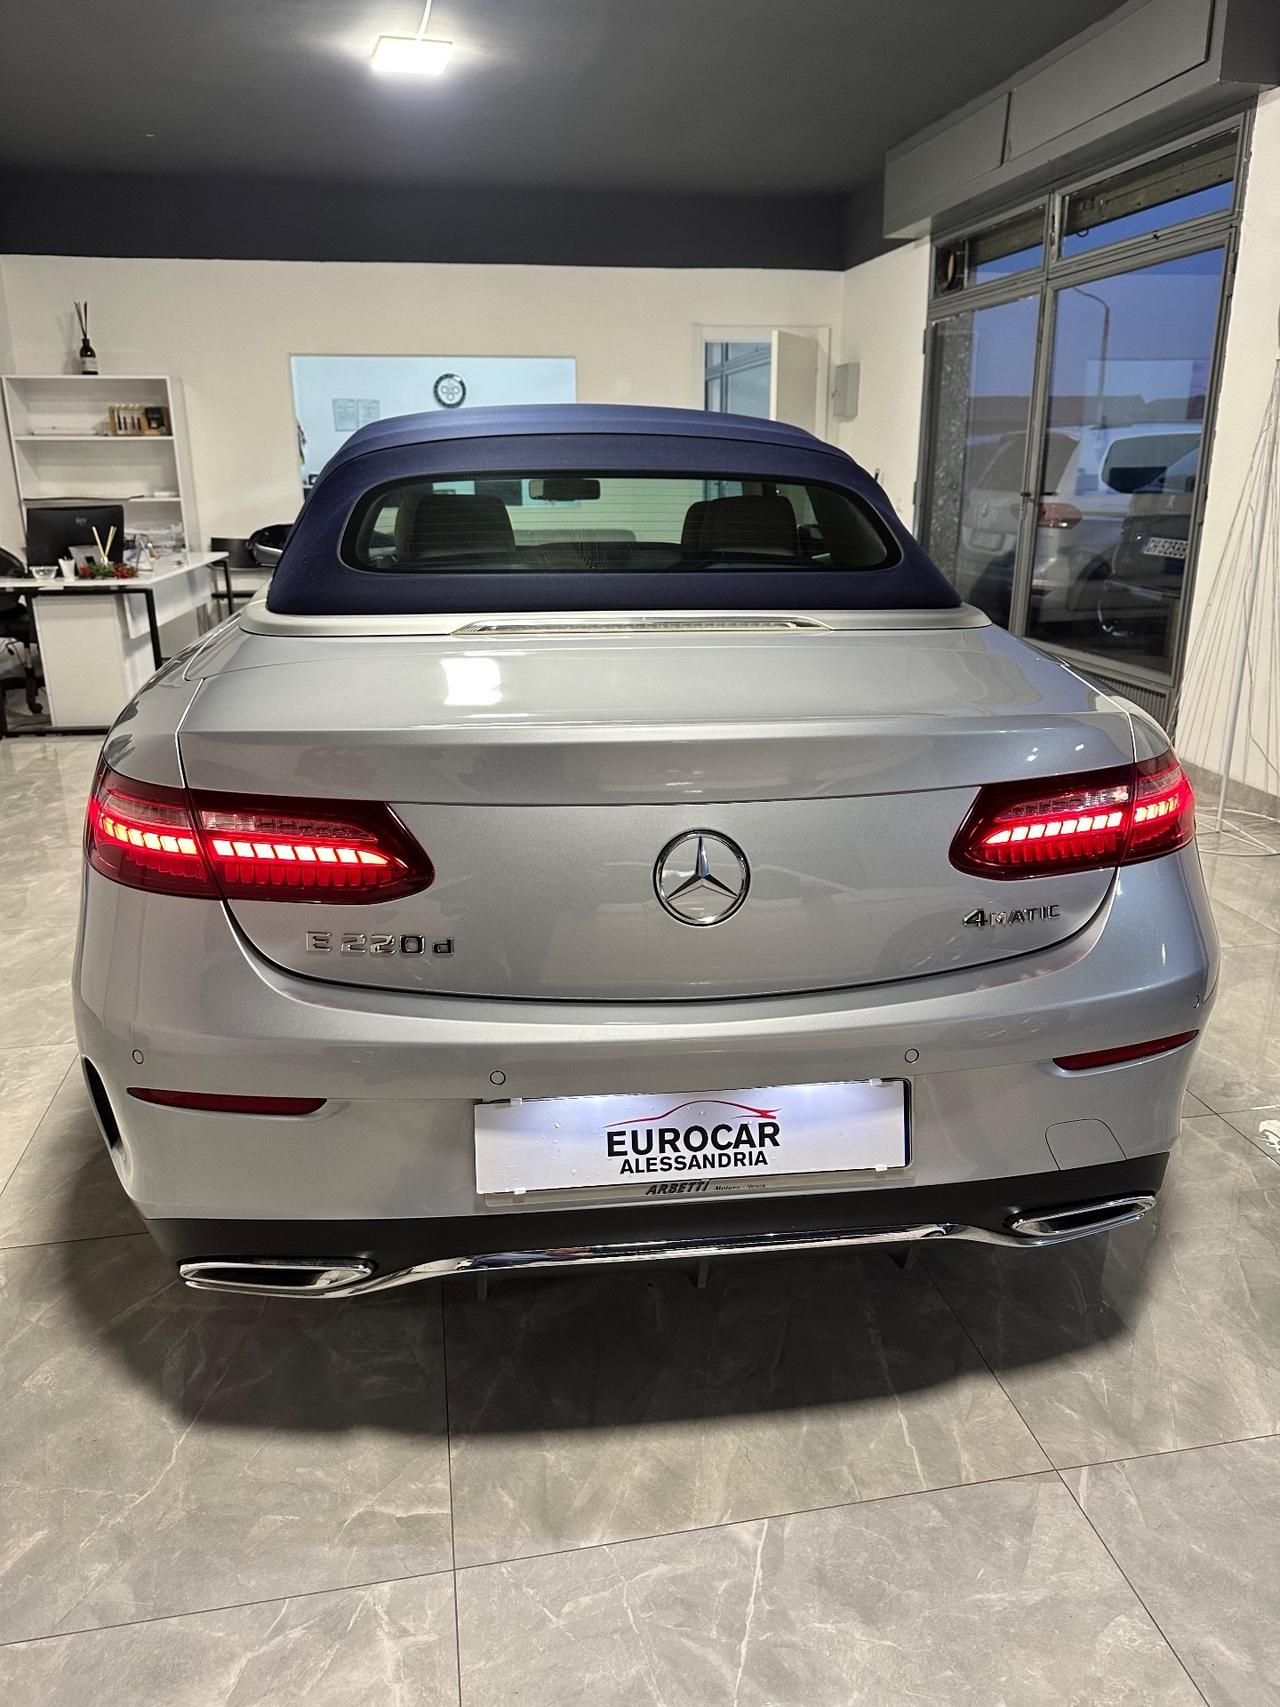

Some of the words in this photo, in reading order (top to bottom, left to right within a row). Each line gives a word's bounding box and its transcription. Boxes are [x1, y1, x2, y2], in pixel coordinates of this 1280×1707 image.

[963, 904, 1061, 928] 4MATIC
[305, 931, 332, 952] E
[340, 932, 426, 955] 220
[432, 937, 455, 955] d
[606, 1121, 781, 1158] EUROCAR
[619, 1150, 769, 1175] ALESSANDRIA
[645, 1179, 711, 1196] ARBETTI
